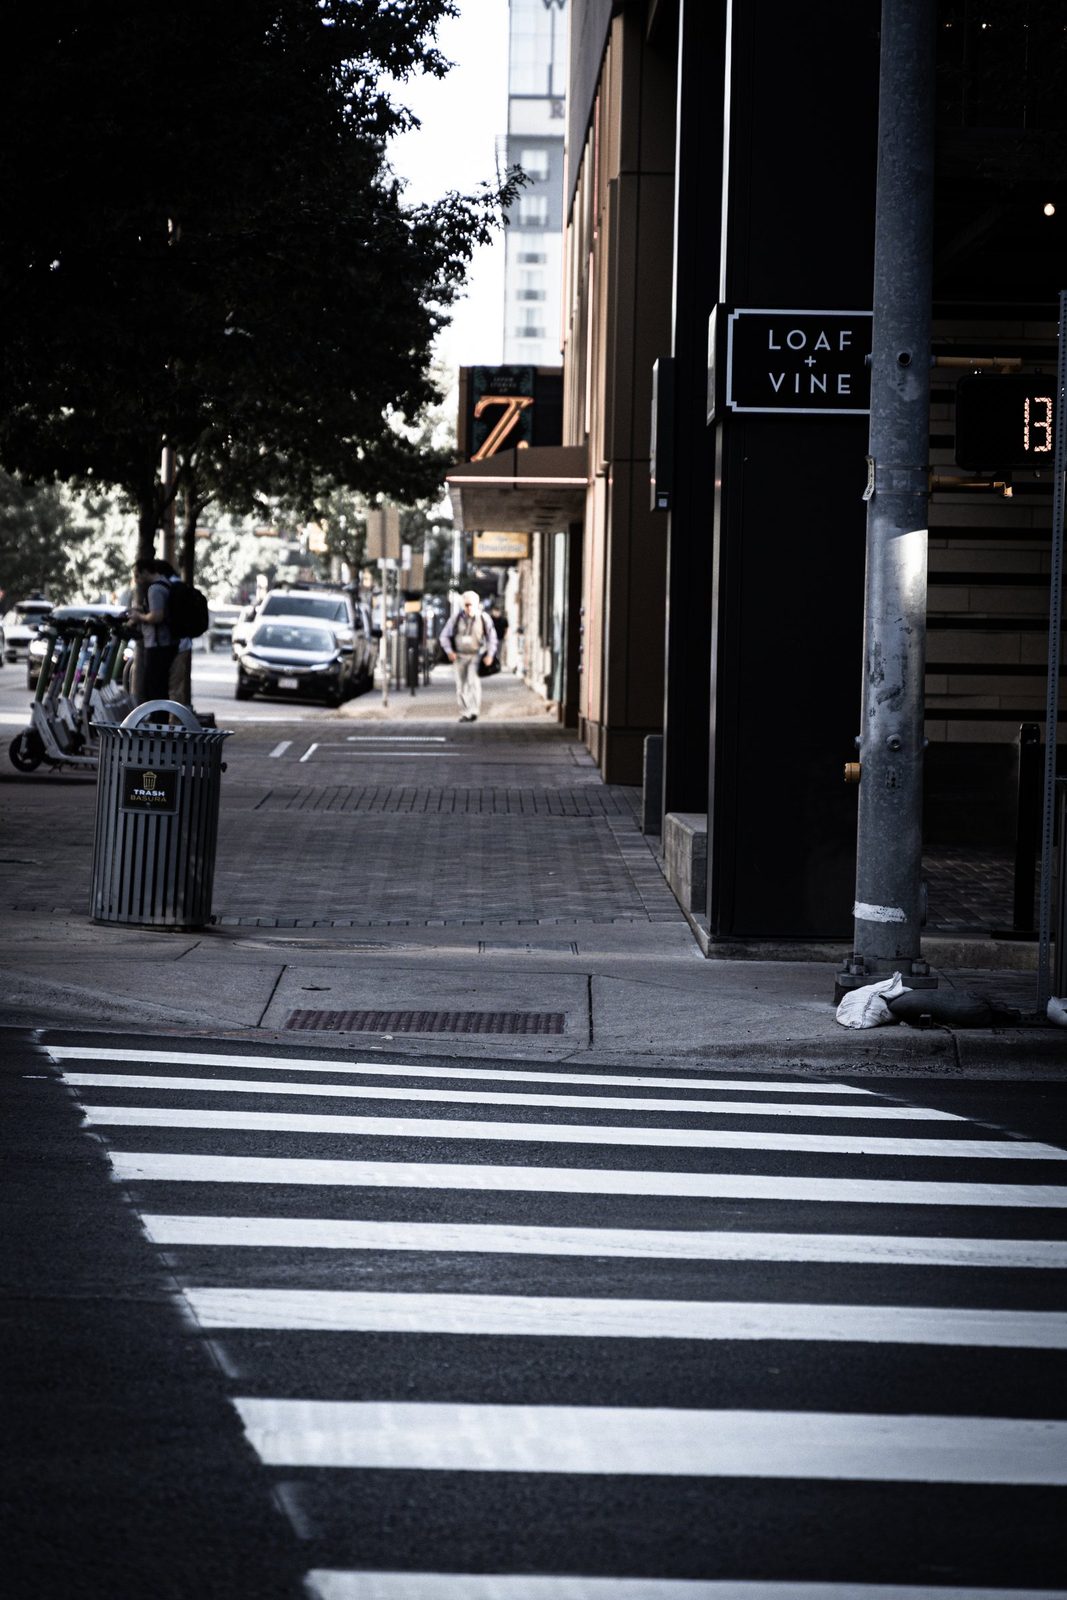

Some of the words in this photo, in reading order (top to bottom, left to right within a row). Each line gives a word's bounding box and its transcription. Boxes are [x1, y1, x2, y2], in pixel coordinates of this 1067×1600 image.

[769, 329, 852, 351] LOAF
[804, 355, 817, 368] +
[768, 372, 851, 394] VINE
[1023, 397, 1053, 452] 13
[130, 794, 167, 802] BASURA
[133, 789, 165, 797] TRASH
